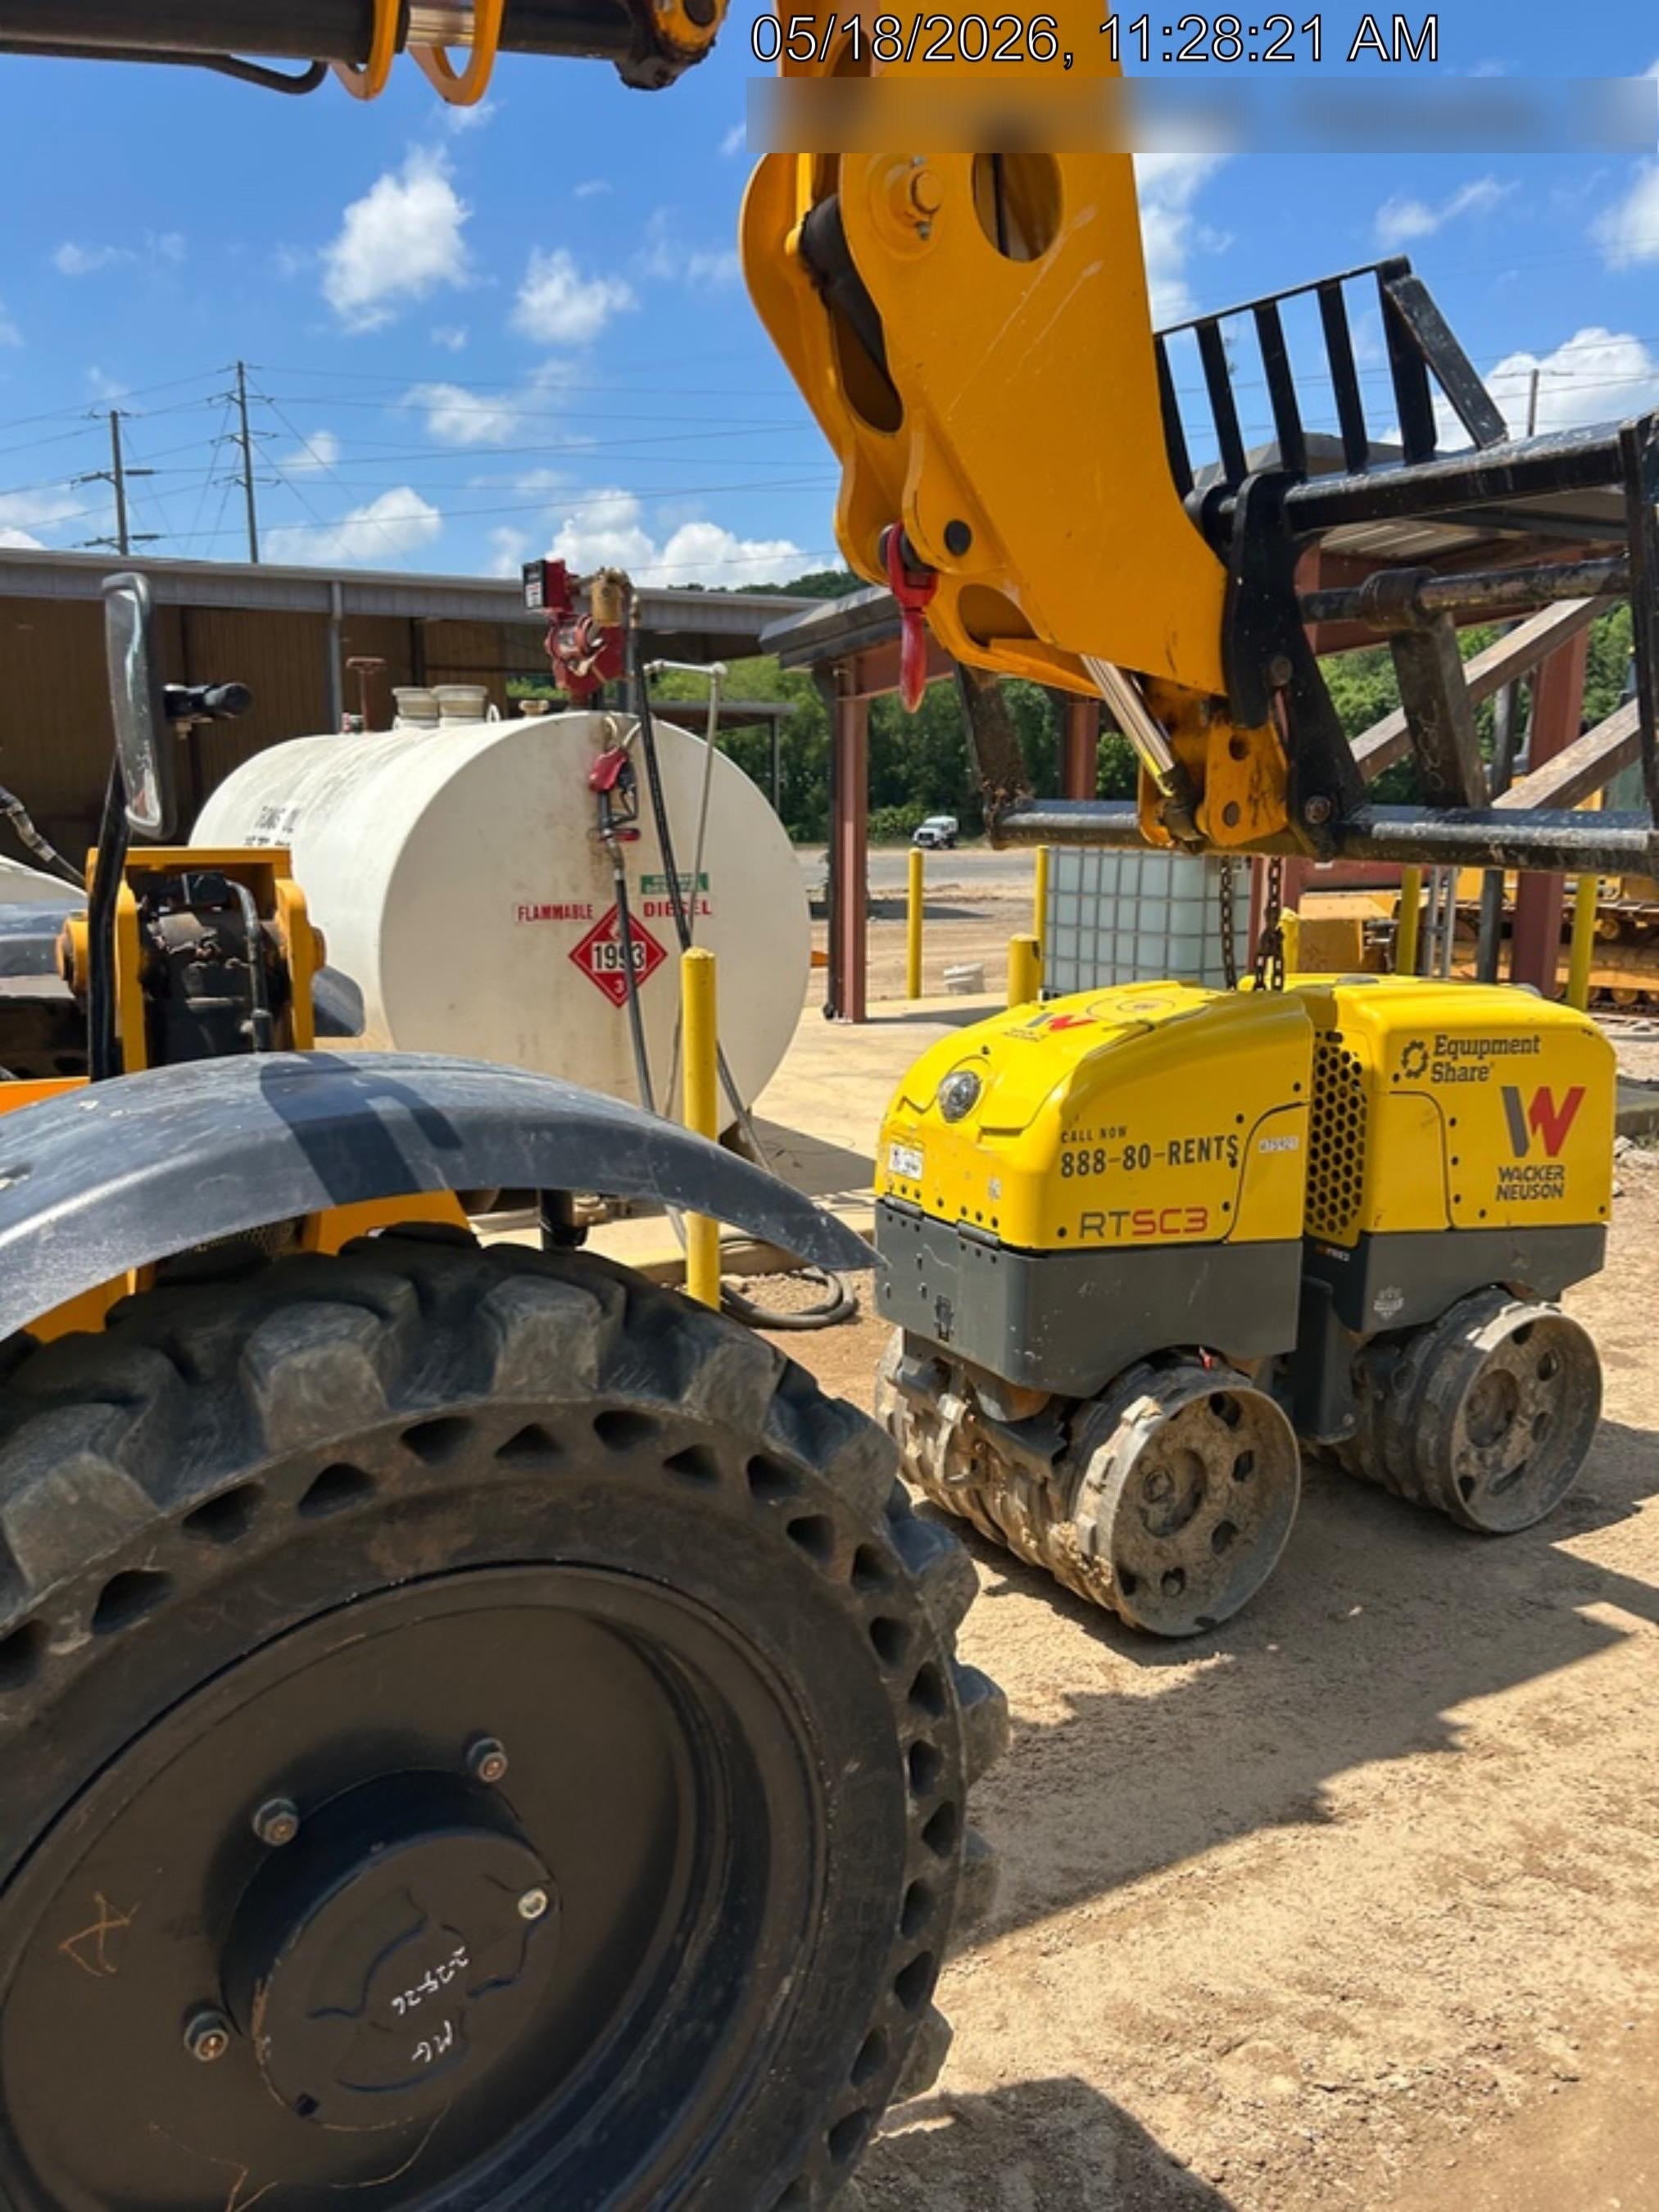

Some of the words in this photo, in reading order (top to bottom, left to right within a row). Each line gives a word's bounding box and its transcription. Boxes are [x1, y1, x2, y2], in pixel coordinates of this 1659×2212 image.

[518, 904, 593, 922] FLAMMABLE
[1434, 1035, 1540, 1060] Equipment
[1431, 1062, 1489, 1083] Share
[1061, 1127, 1093, 1144] CALL
[1100, 1126, 1128, 1140] NOW
[1061, 1134, 1239, 1178] 888-80-RENTS
[1498, 1164, 1565, 1183] WACKER
[1495, 1184, 1565, 1202] NEUSON
[1079, 1207, 1208, 1239] RTSC3
